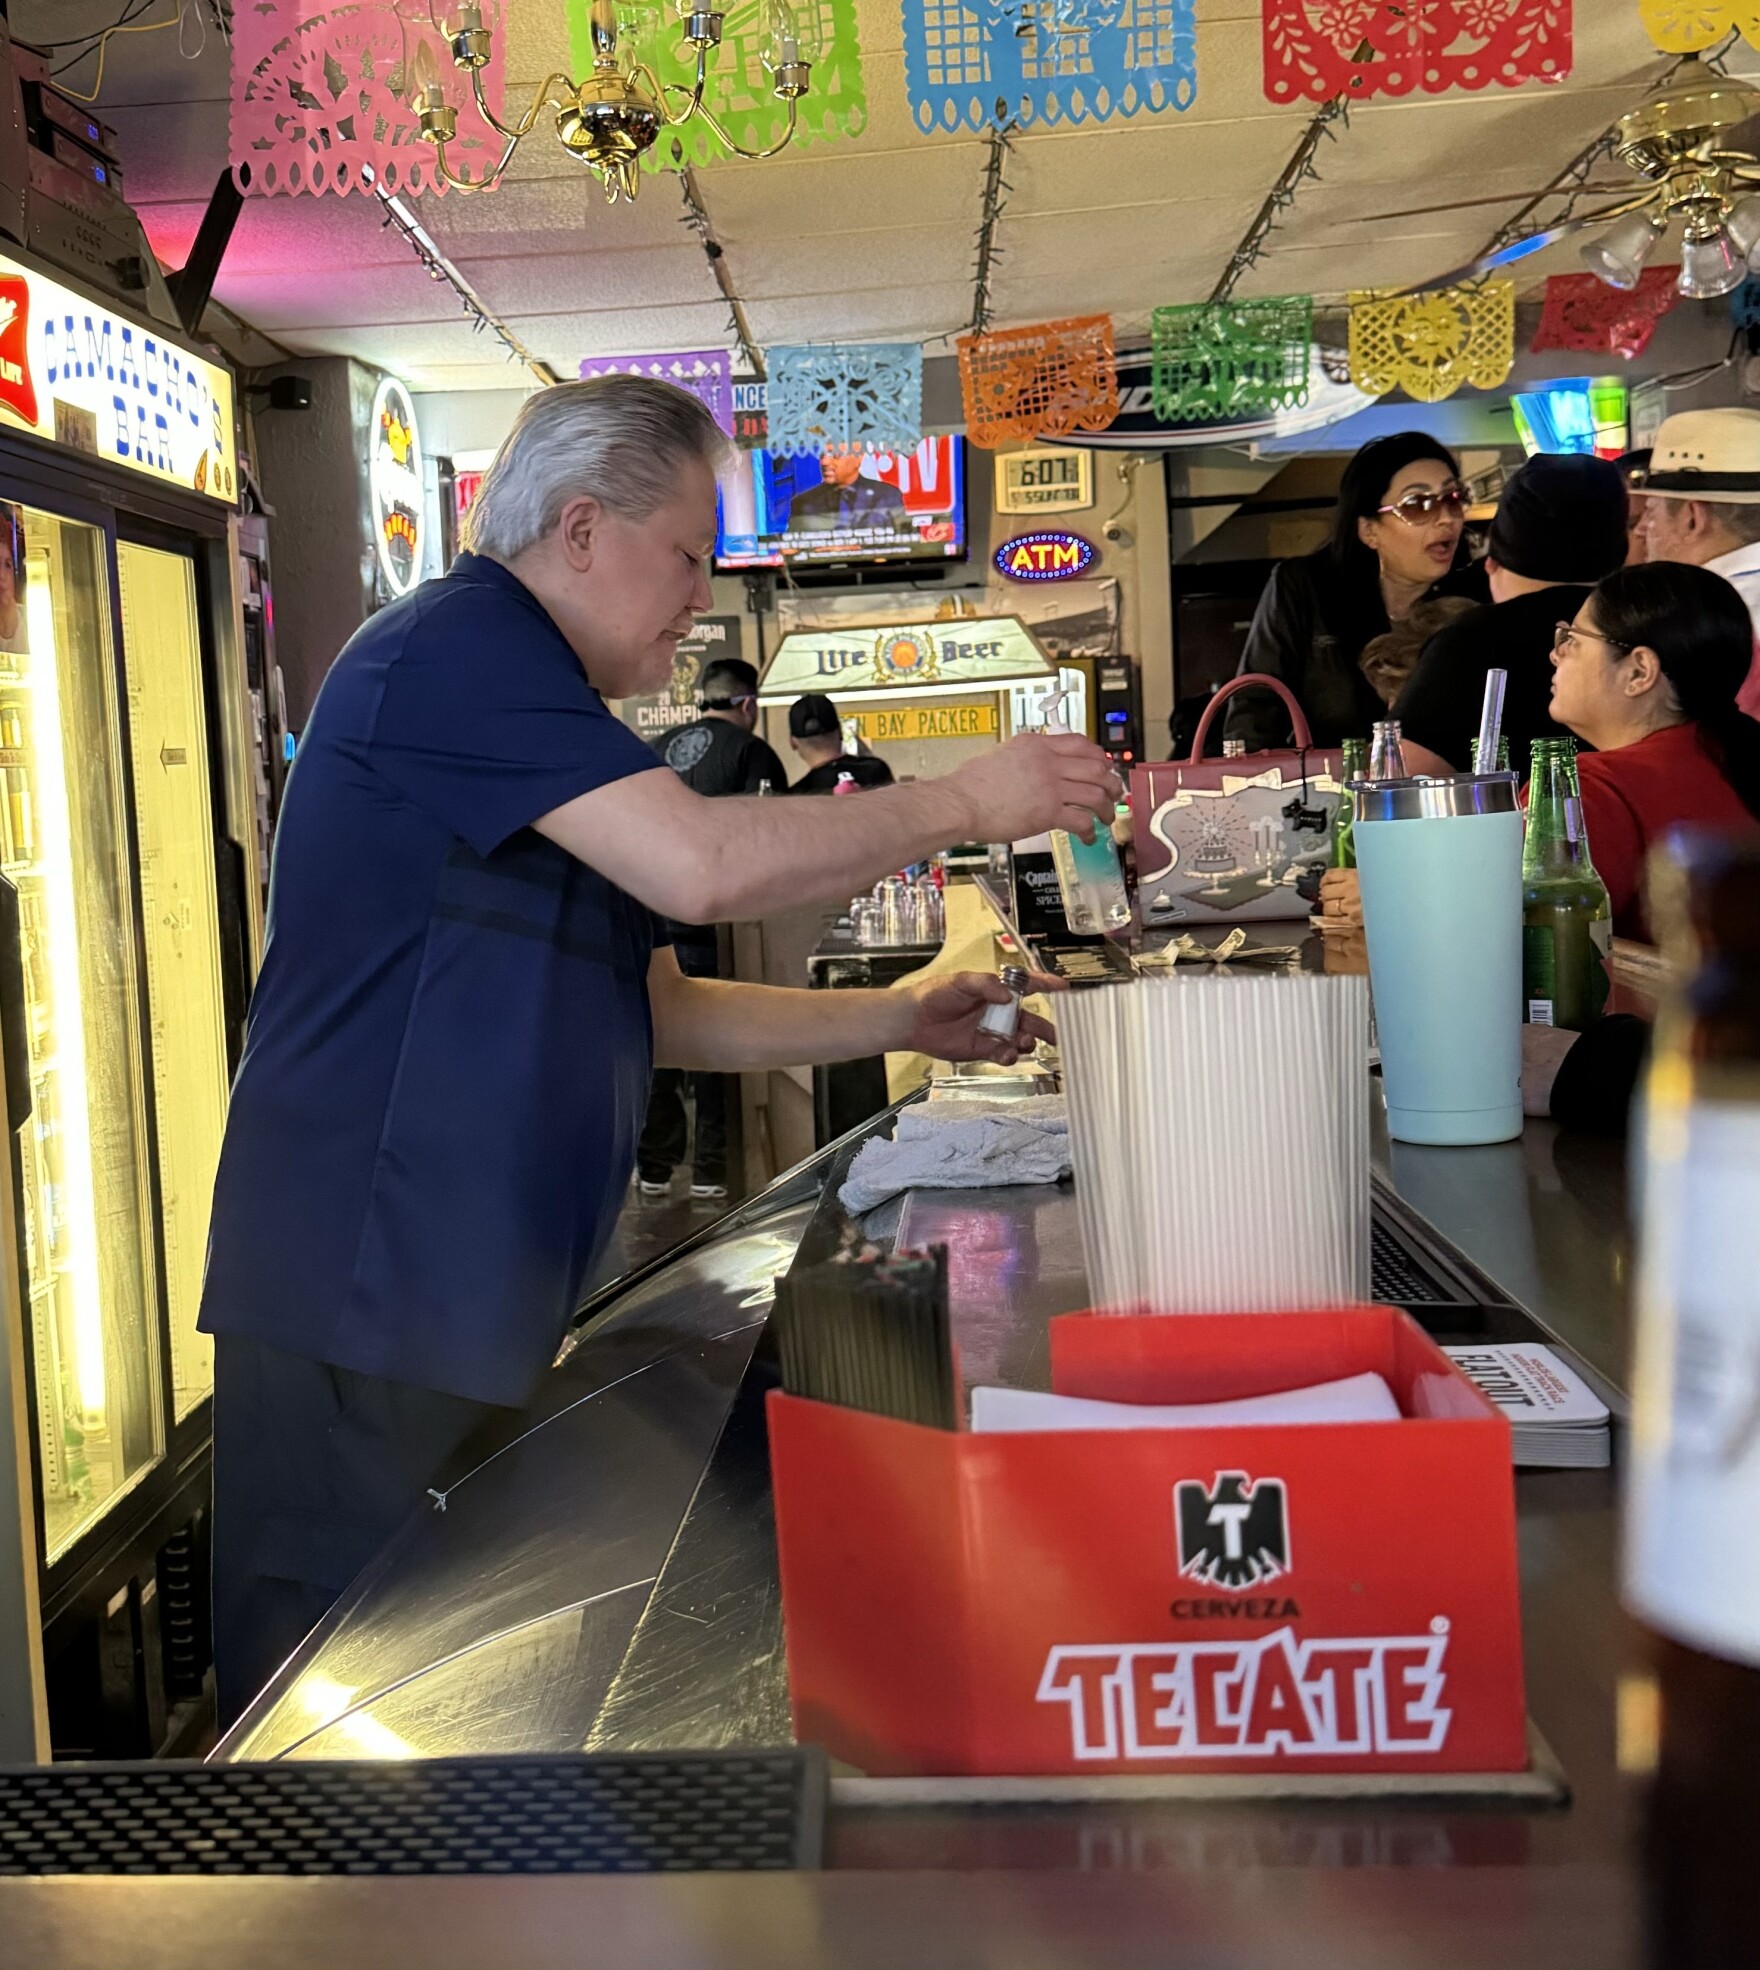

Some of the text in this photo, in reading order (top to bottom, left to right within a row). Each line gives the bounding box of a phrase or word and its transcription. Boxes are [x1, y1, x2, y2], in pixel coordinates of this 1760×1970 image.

[44, 315, 223, 456] CAMACHO'S
[113, 394, 174, 474] BAR
[1010, 543, 1080, 571] ATM
[688, 623, 726, 643] organ
[816, 649, 868, 676] Lite
[941, 640, 1004, 664] Beer
[878, 713, 907, 737] BAY
[918, 708, 979, 735] PACKER
[1035, 894, 1063, 906] SPICE
[1451, 1354, 1536, 1407] FLAT OUT
[1169, 1597, 1302, 1621] CERVEZA
[1036, 1625, 1453, 1760] TECATE
